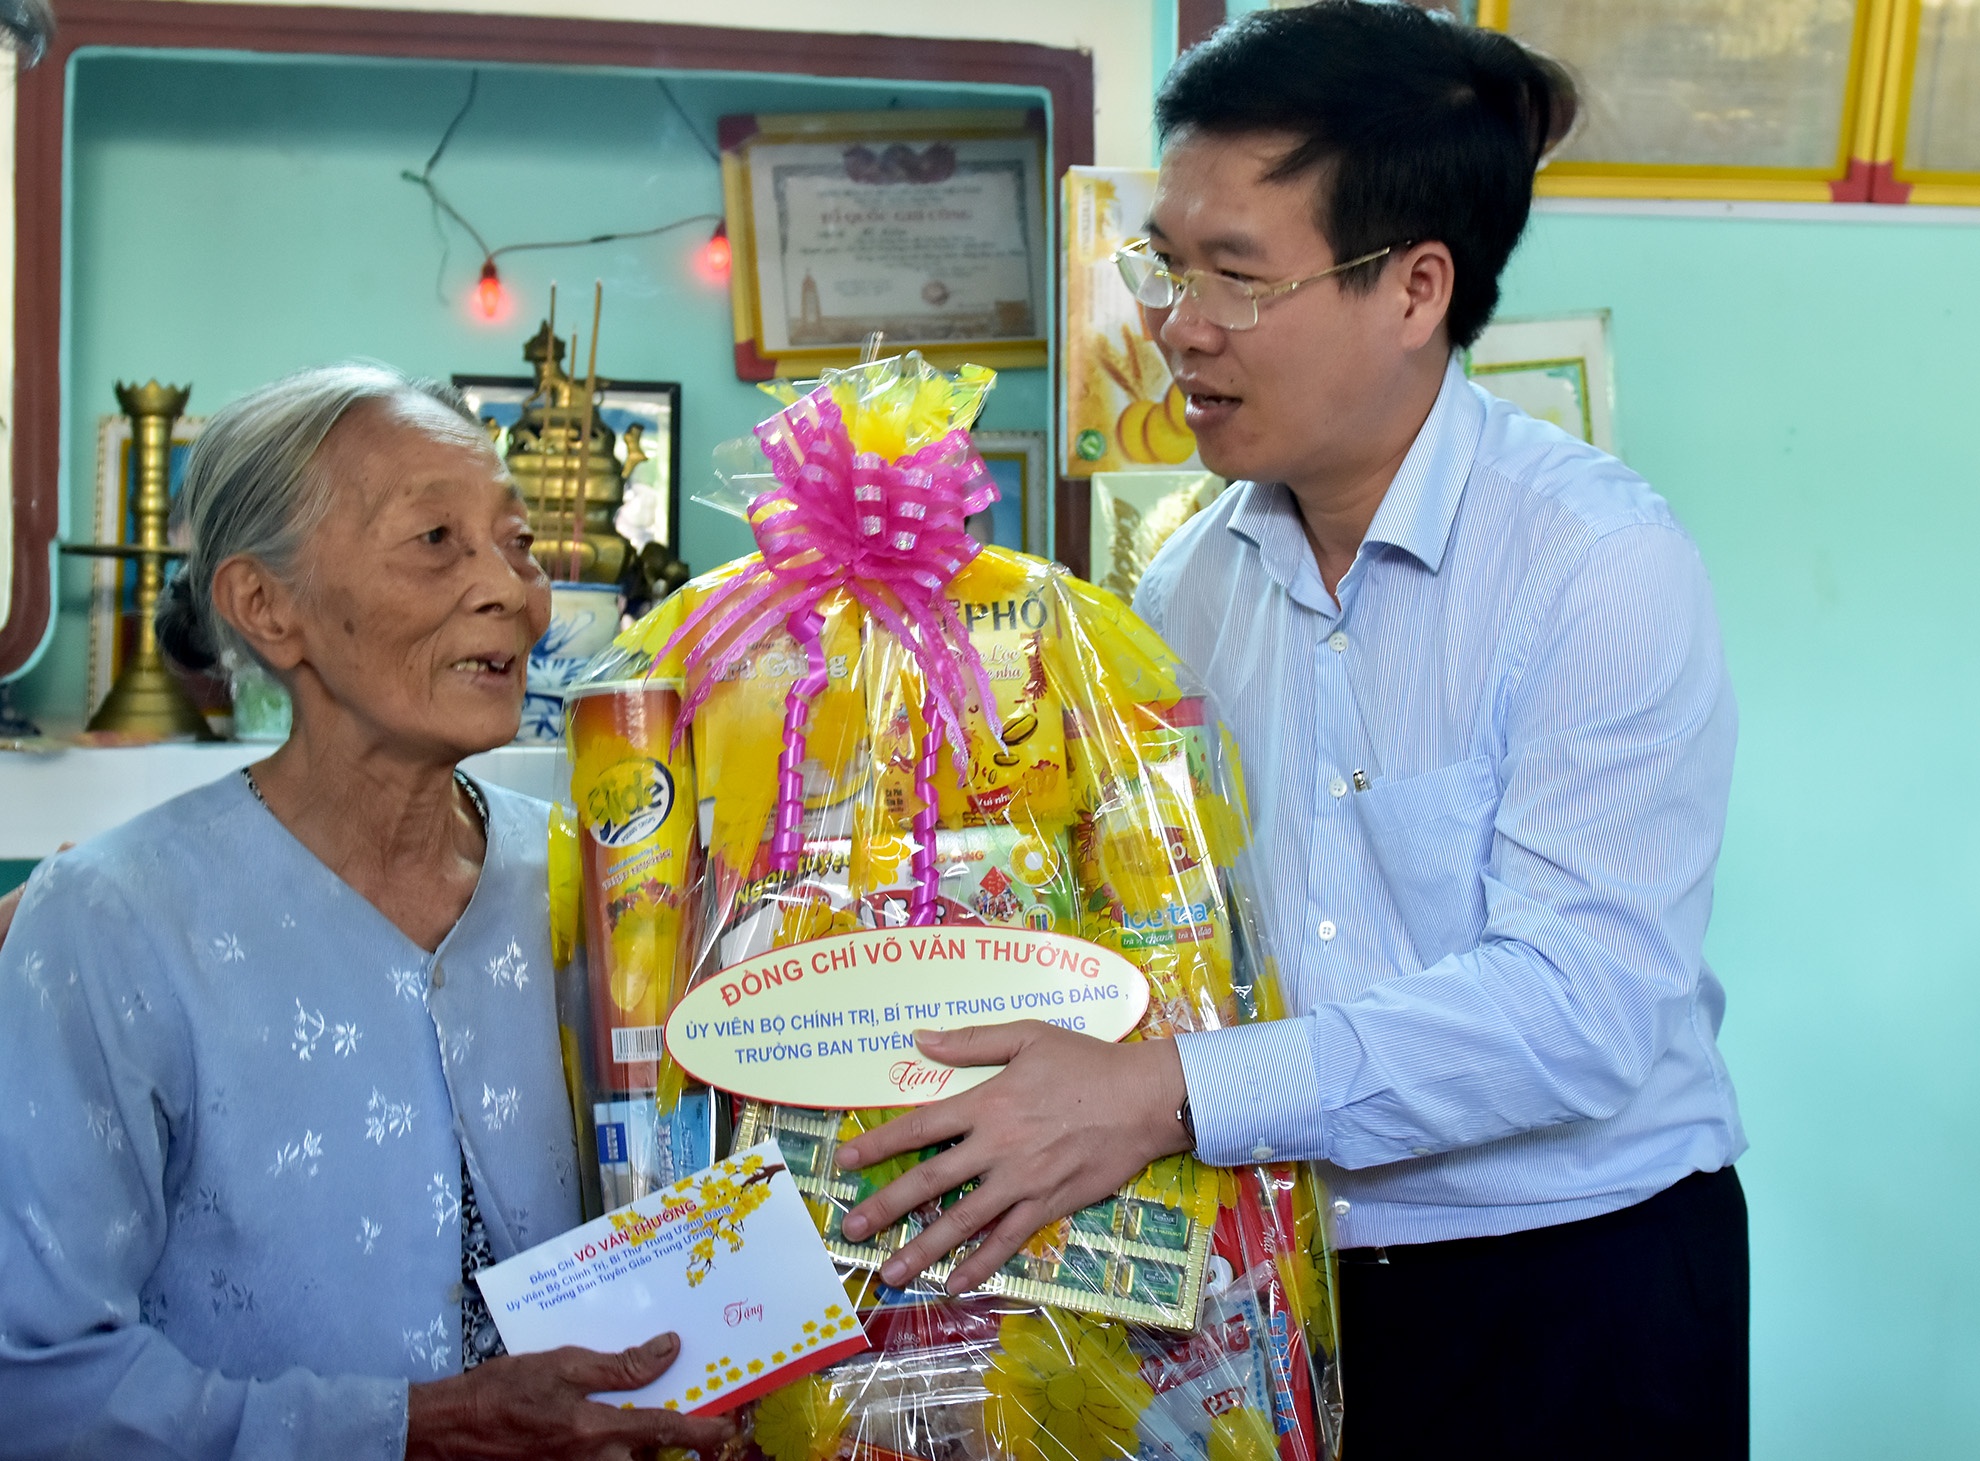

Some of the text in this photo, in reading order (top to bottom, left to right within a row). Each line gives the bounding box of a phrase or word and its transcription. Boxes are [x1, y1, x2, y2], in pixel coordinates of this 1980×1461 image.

[1122, 901, 1208, 930] ice tea
[811, 940, 857, 974] CHÍ
[863, 936, 902, 965] VÕ
[909, 933, 966, 961] VĂN
[975, 939, 1101, 979] THƯỞNG
[714, 1017, 755, 1037] VIÊN
[760, 1015, 785, 1035] BỘ
[791, 1010, 843, 1030] CHÍNH
[848, 1009, 880, 1027] TRỊ,
[884, 1003, 900, 1022] BÍ
[904, 1002, 941, 1020] THƯ
[946, 997, 1005, 1016] TRUNG
[1010, 990, 1064, 1010] ƯƠNG
[735, 1043, 812, 1065] TRƯỞNG
[818, 1039, 853, 1057] BAN
[857, 1031, 914, 1053] TUYÊN
[889, 1060, 955, 1097] Tặng
[598, 1229, 630, 1252] VĂN
[645, 1233, 674, 1249] Trung
[654, 1242, 683, 1258] Trung
